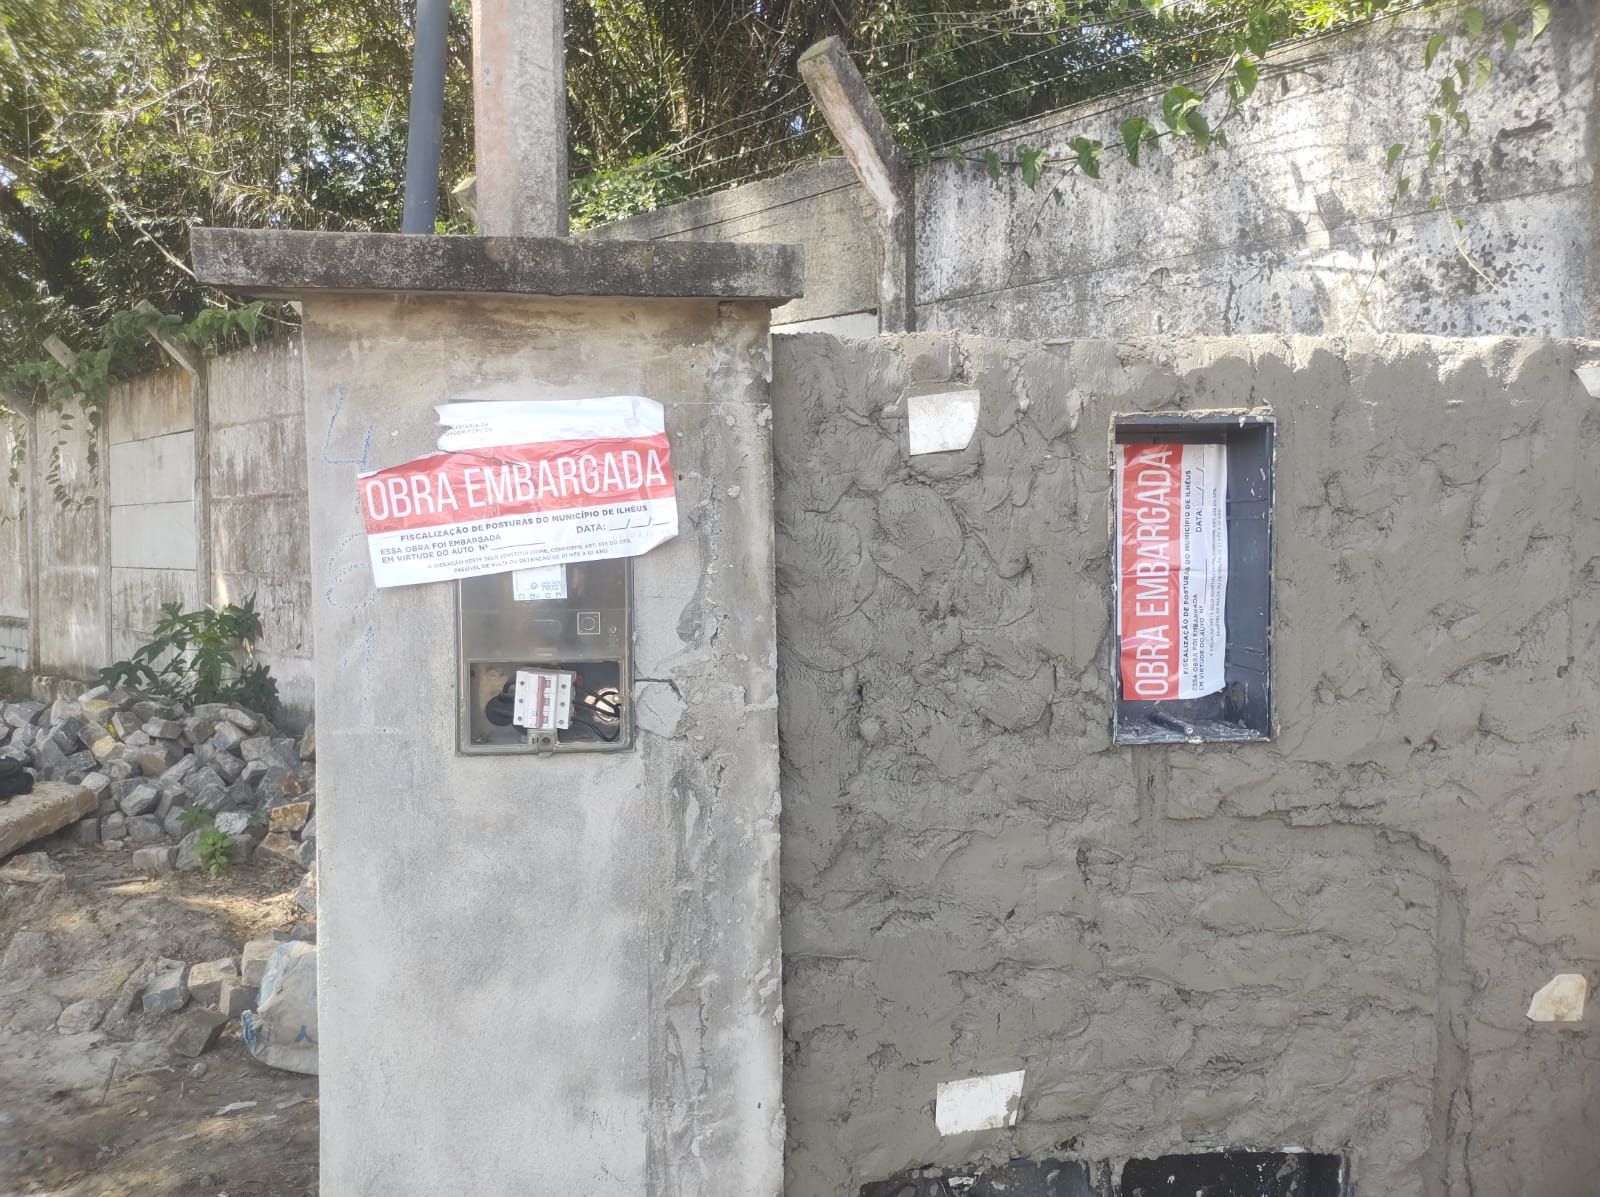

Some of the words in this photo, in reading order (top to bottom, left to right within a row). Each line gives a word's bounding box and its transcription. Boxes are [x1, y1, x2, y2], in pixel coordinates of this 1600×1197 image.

[364, 474, 458, 521] OBRA
[464, 449, 667, 508] EMBARGADA
[1184, 499, 1191, 509] DE
[400, 526, 469, 542] FISCALIZAÇÃO
[471, 523, 484, 532] DE
[485, 516, 534, 531] POSTURAS
[536, 516, 549, 525] DO
[552, 509, 599, 523] MUNICÍPIO
[602, 508, 614, 516] DE
[616, 504, 649, 514] ILHÉUS
[576, 523, 607, 534] DATA:
[1183, 511, 1191, 552] MUNICÍPIO
[1195, 507, 1203, 532] DATA:
[380, 547, 402, 556] ESSA
[405, 544, 430, 553] OBRA
[432, 541, 447, 550] FOI
[448, 534, 502, 547] EMBARGADA
[1135, 450, 1174, 616] EMBARGADA
[381, 555, 395, 564] EM
[397, 551, 434, 563] VIRTUDE
[436, 549, 449, 557] DO
[452, 546, 474, 555] AUTO
[1184, 553, 1191, 564] DO
[1183, 566, 1191, 605] POSTURAS
[1183, 606, 1189, 617] DE
[1182, 618, 1190, 675] FISCALIZAÇÃO
[1199, 637, 1205, 648] DO
[1134, 624, 1170, 695] OBRA
